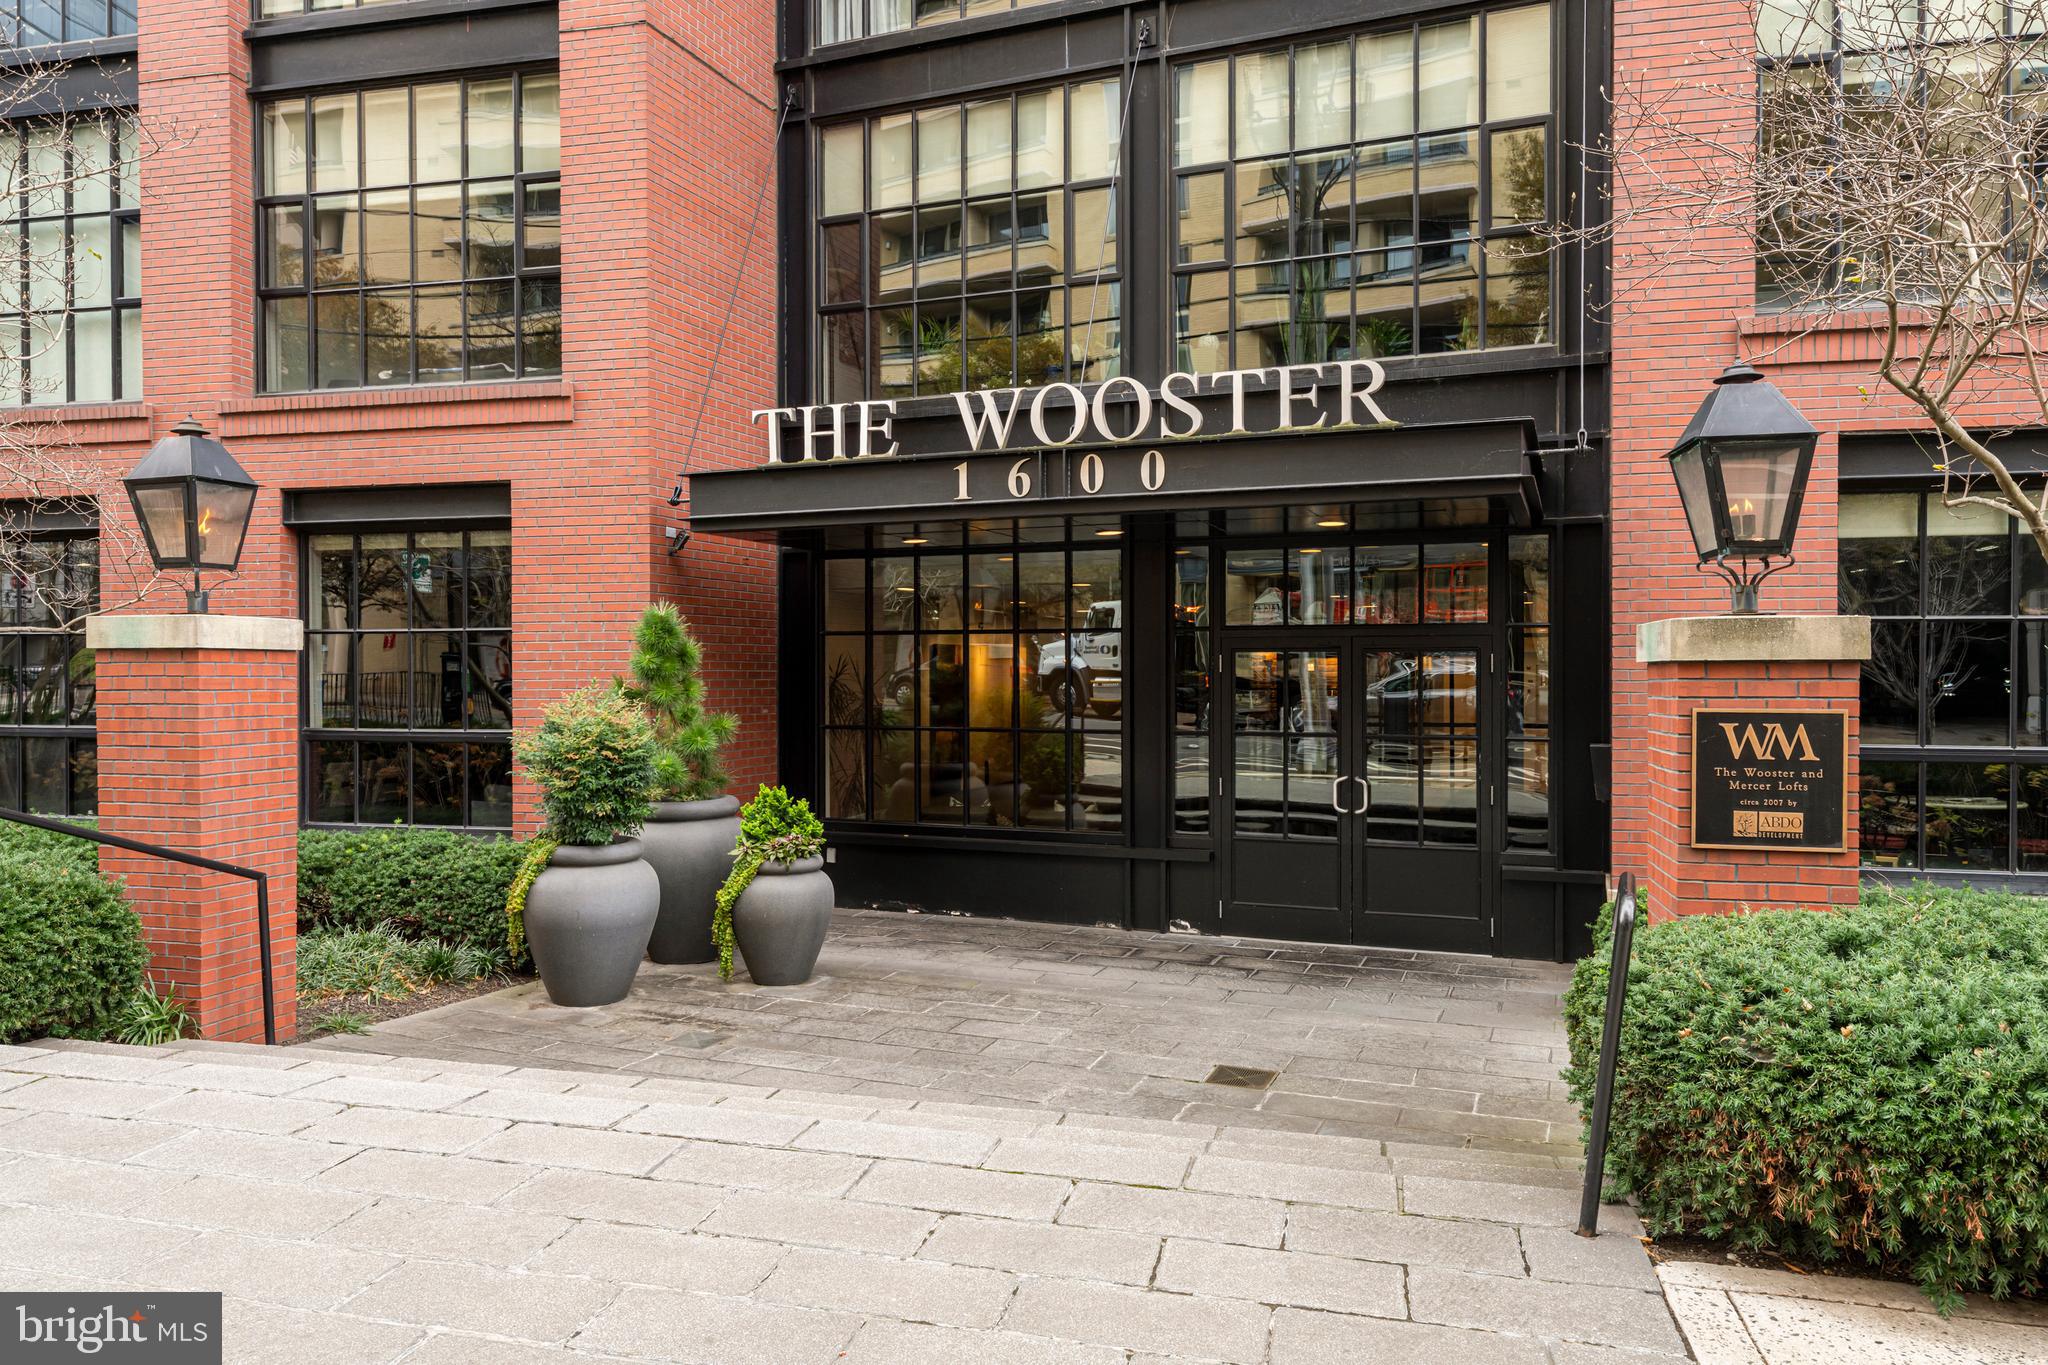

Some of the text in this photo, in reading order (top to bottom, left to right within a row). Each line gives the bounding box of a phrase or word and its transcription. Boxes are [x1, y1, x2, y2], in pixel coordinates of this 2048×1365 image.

[751, 360, 1393, 465] THE WOOSTER
[953, 449, 1167, 501] 1600
[1718, 722, 1821, 761] WM
[1714, 767, 1823, 778] The Wooster and
[1729, 780, 1809, 792] Mercer Lofts
[1760, 816, 1802, 828] ABDO
